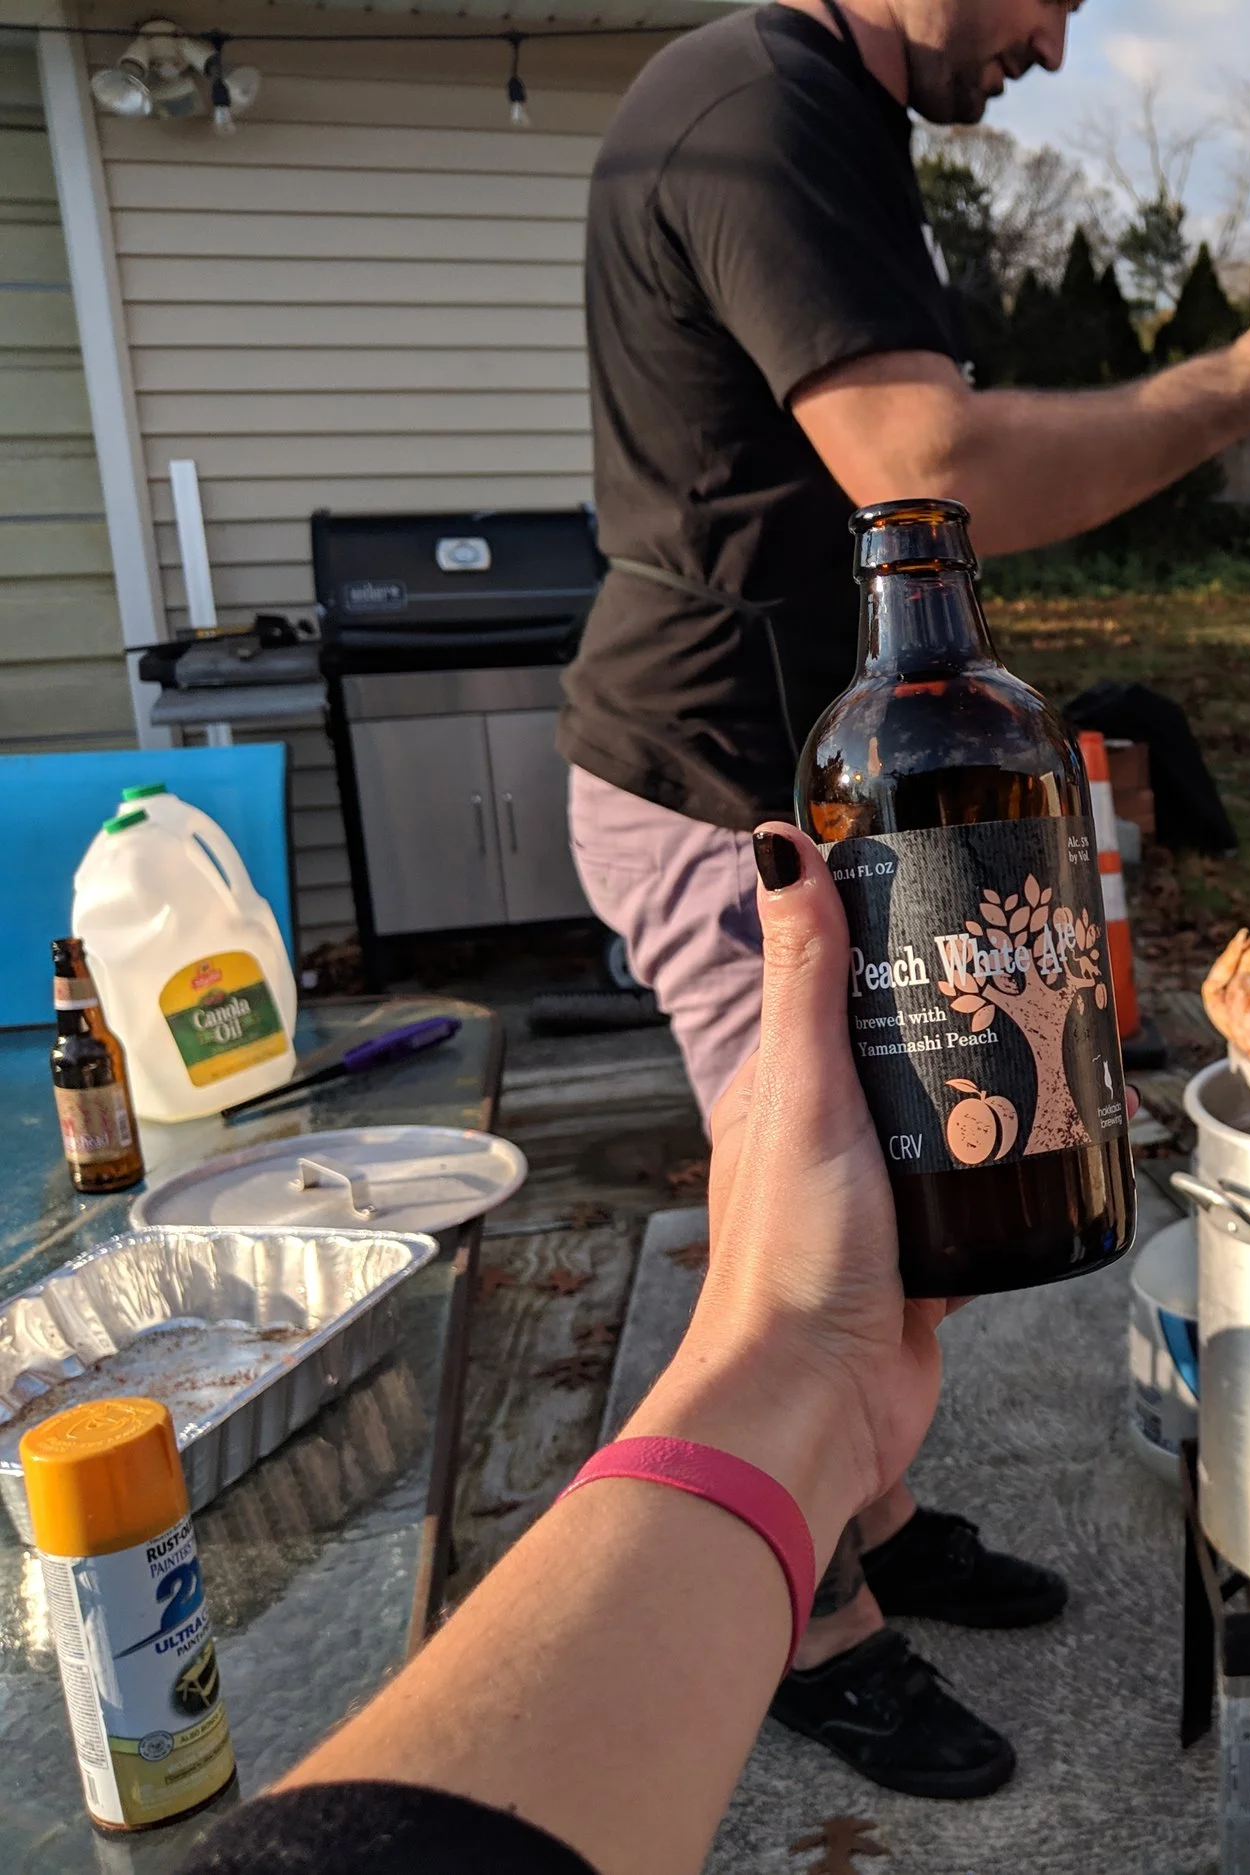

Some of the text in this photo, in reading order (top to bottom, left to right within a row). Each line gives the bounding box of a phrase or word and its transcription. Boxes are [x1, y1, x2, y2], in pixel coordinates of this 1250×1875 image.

[833, 861, 894, 881] 10.14 FL OZ
[1068, 851, 1078, 865] by
[851, 921, 1077, 998] Peach White Ale
[192, 996, 251, 1032] Canola
[855, 1006, 947, 1030] brewed with
[214, 1017, 243, 1045] Oil
[857, 1028, 998, 1057] Yamanashi Peach
[889, 1133, 923, 1160] CRV
[154, 1616, 204, 1655] ULTRA
